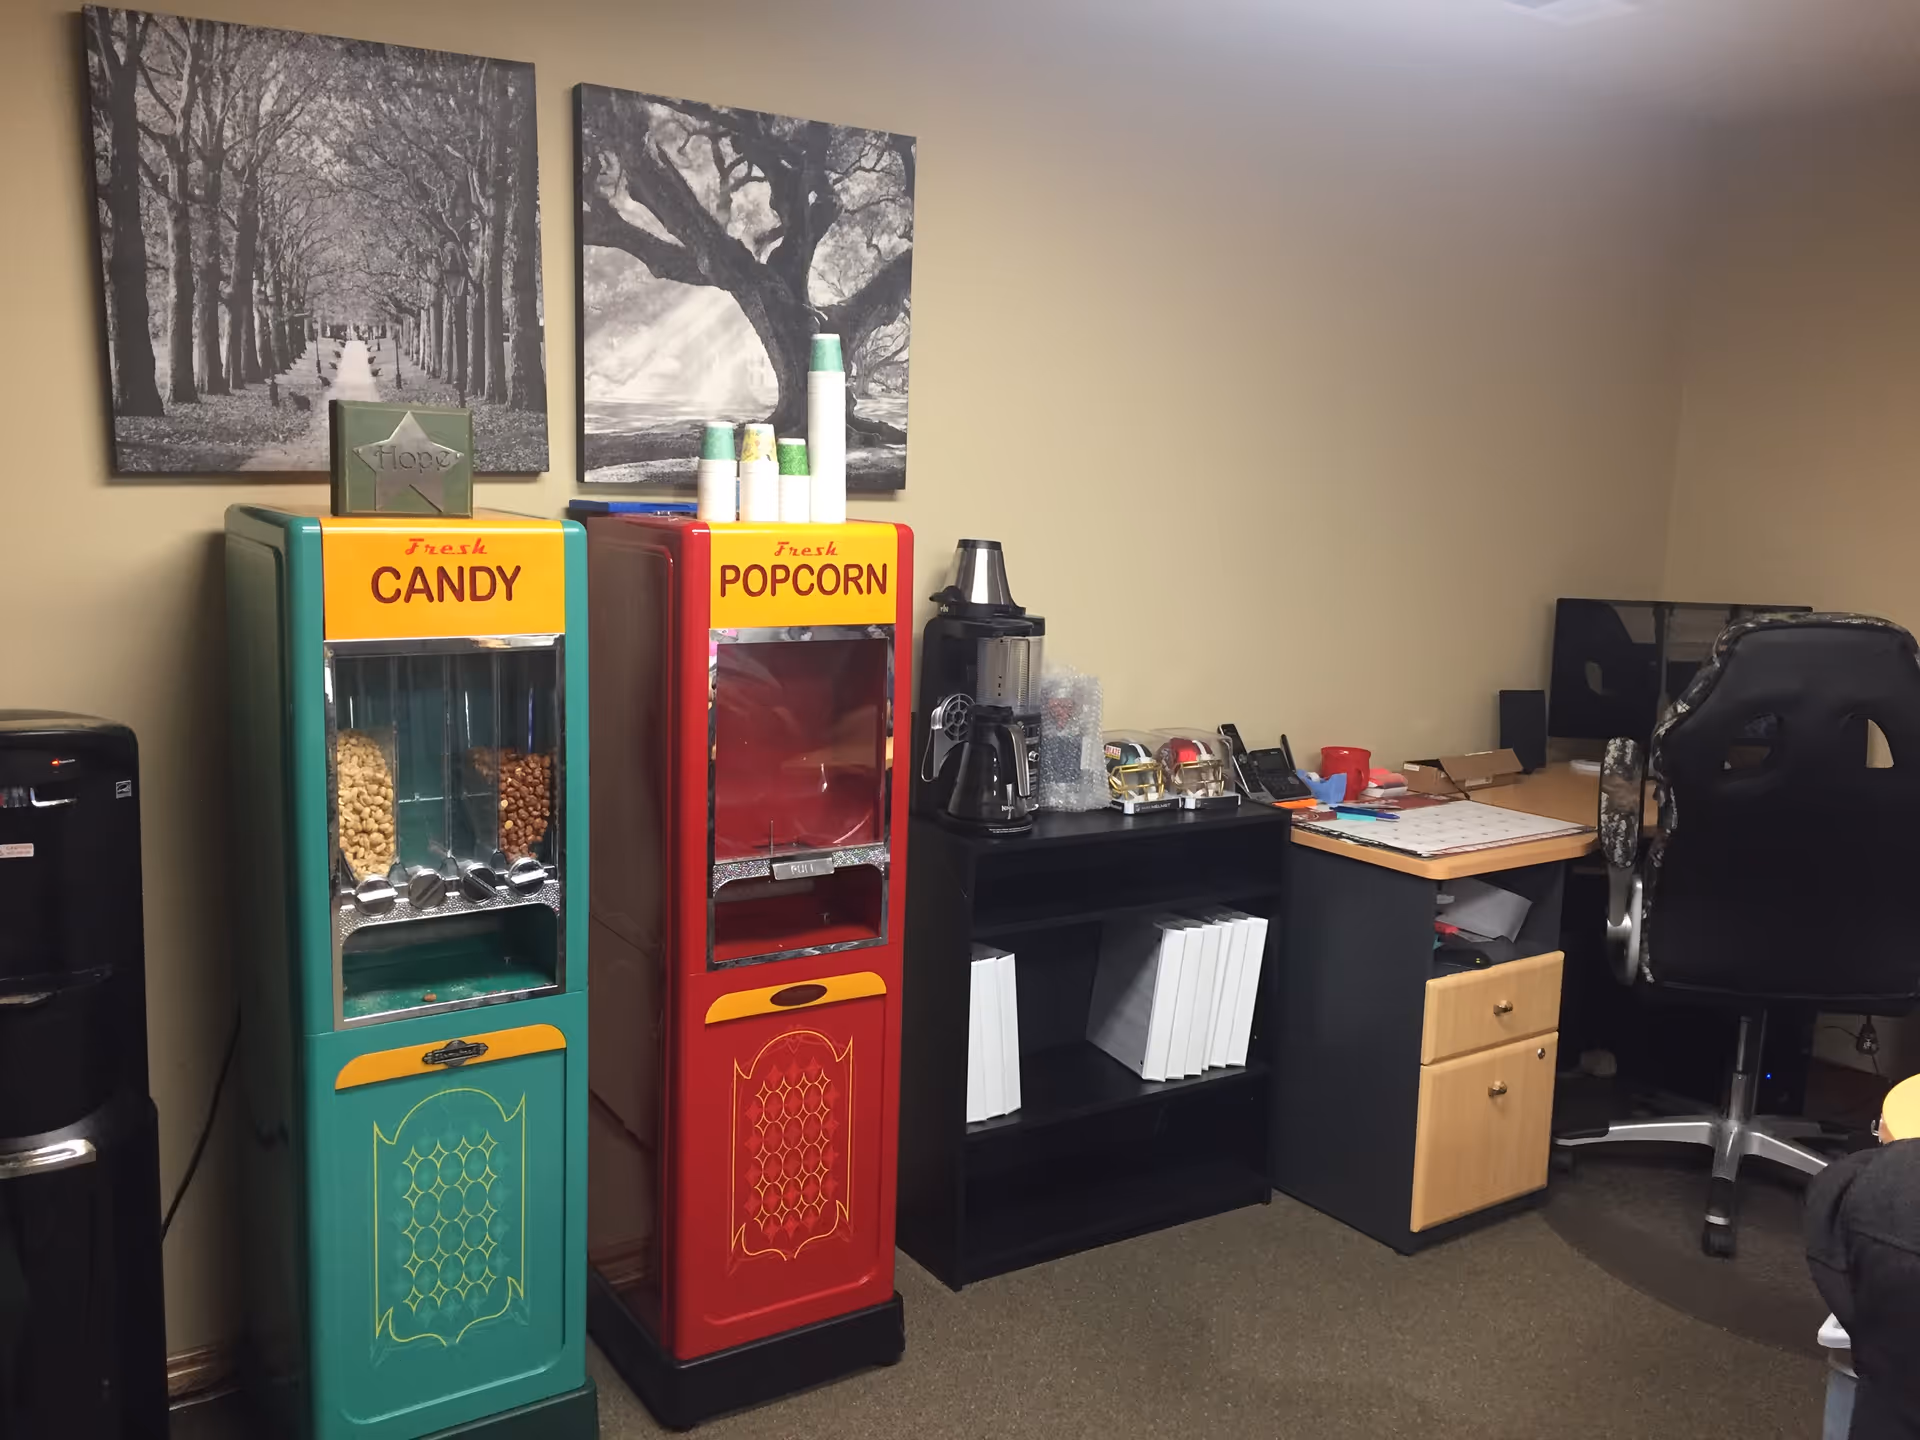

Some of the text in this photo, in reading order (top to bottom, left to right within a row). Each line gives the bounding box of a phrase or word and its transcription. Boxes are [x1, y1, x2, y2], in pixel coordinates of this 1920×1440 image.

[374, 445, 451, 473] Hope
[404, 537, 488, 555] Fresh
[774, 541, 838, 556] Fresh
[371, 565, 522, 603] CANDY
[720, 563, 888, 598] POPCORN
